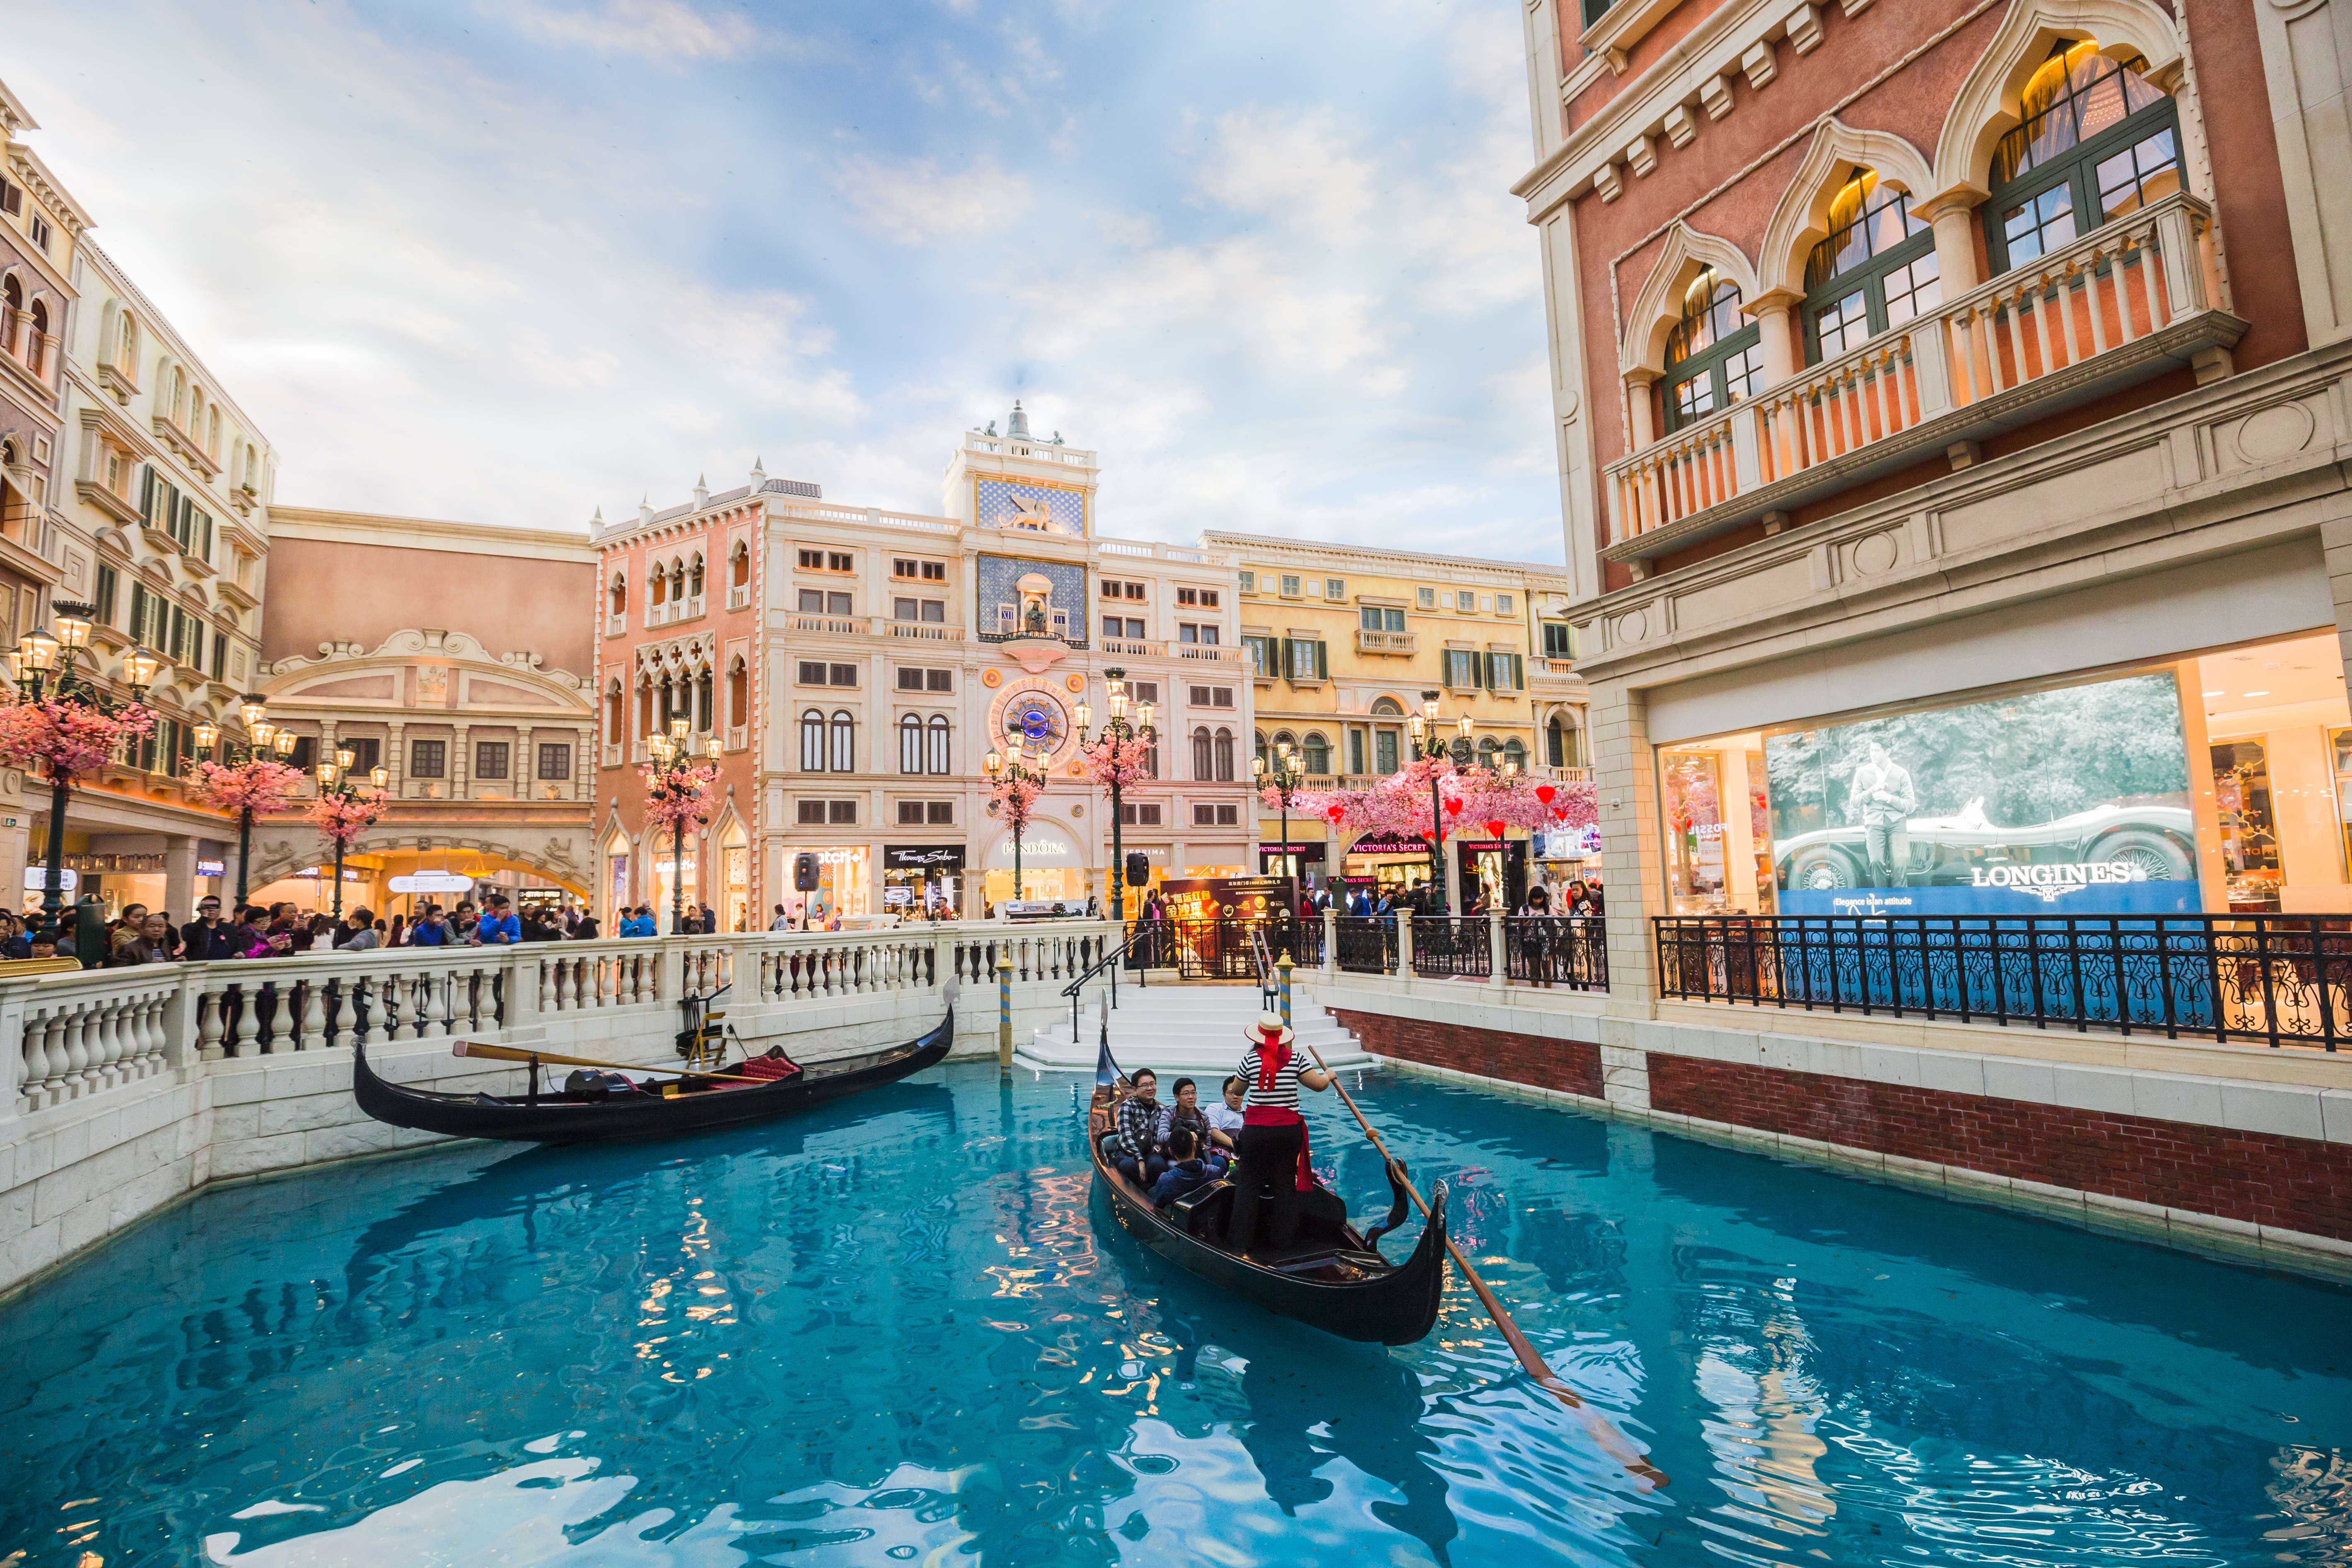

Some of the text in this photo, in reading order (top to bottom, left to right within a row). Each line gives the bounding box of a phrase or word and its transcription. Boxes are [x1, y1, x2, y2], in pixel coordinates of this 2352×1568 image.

[1002, 611, 1012, 619] XII
[1971, 862, 2130, 887] LONGINES
[1835, 898, 1865, 906] Elegance
[1884, 896, 1912, 905] attitude
